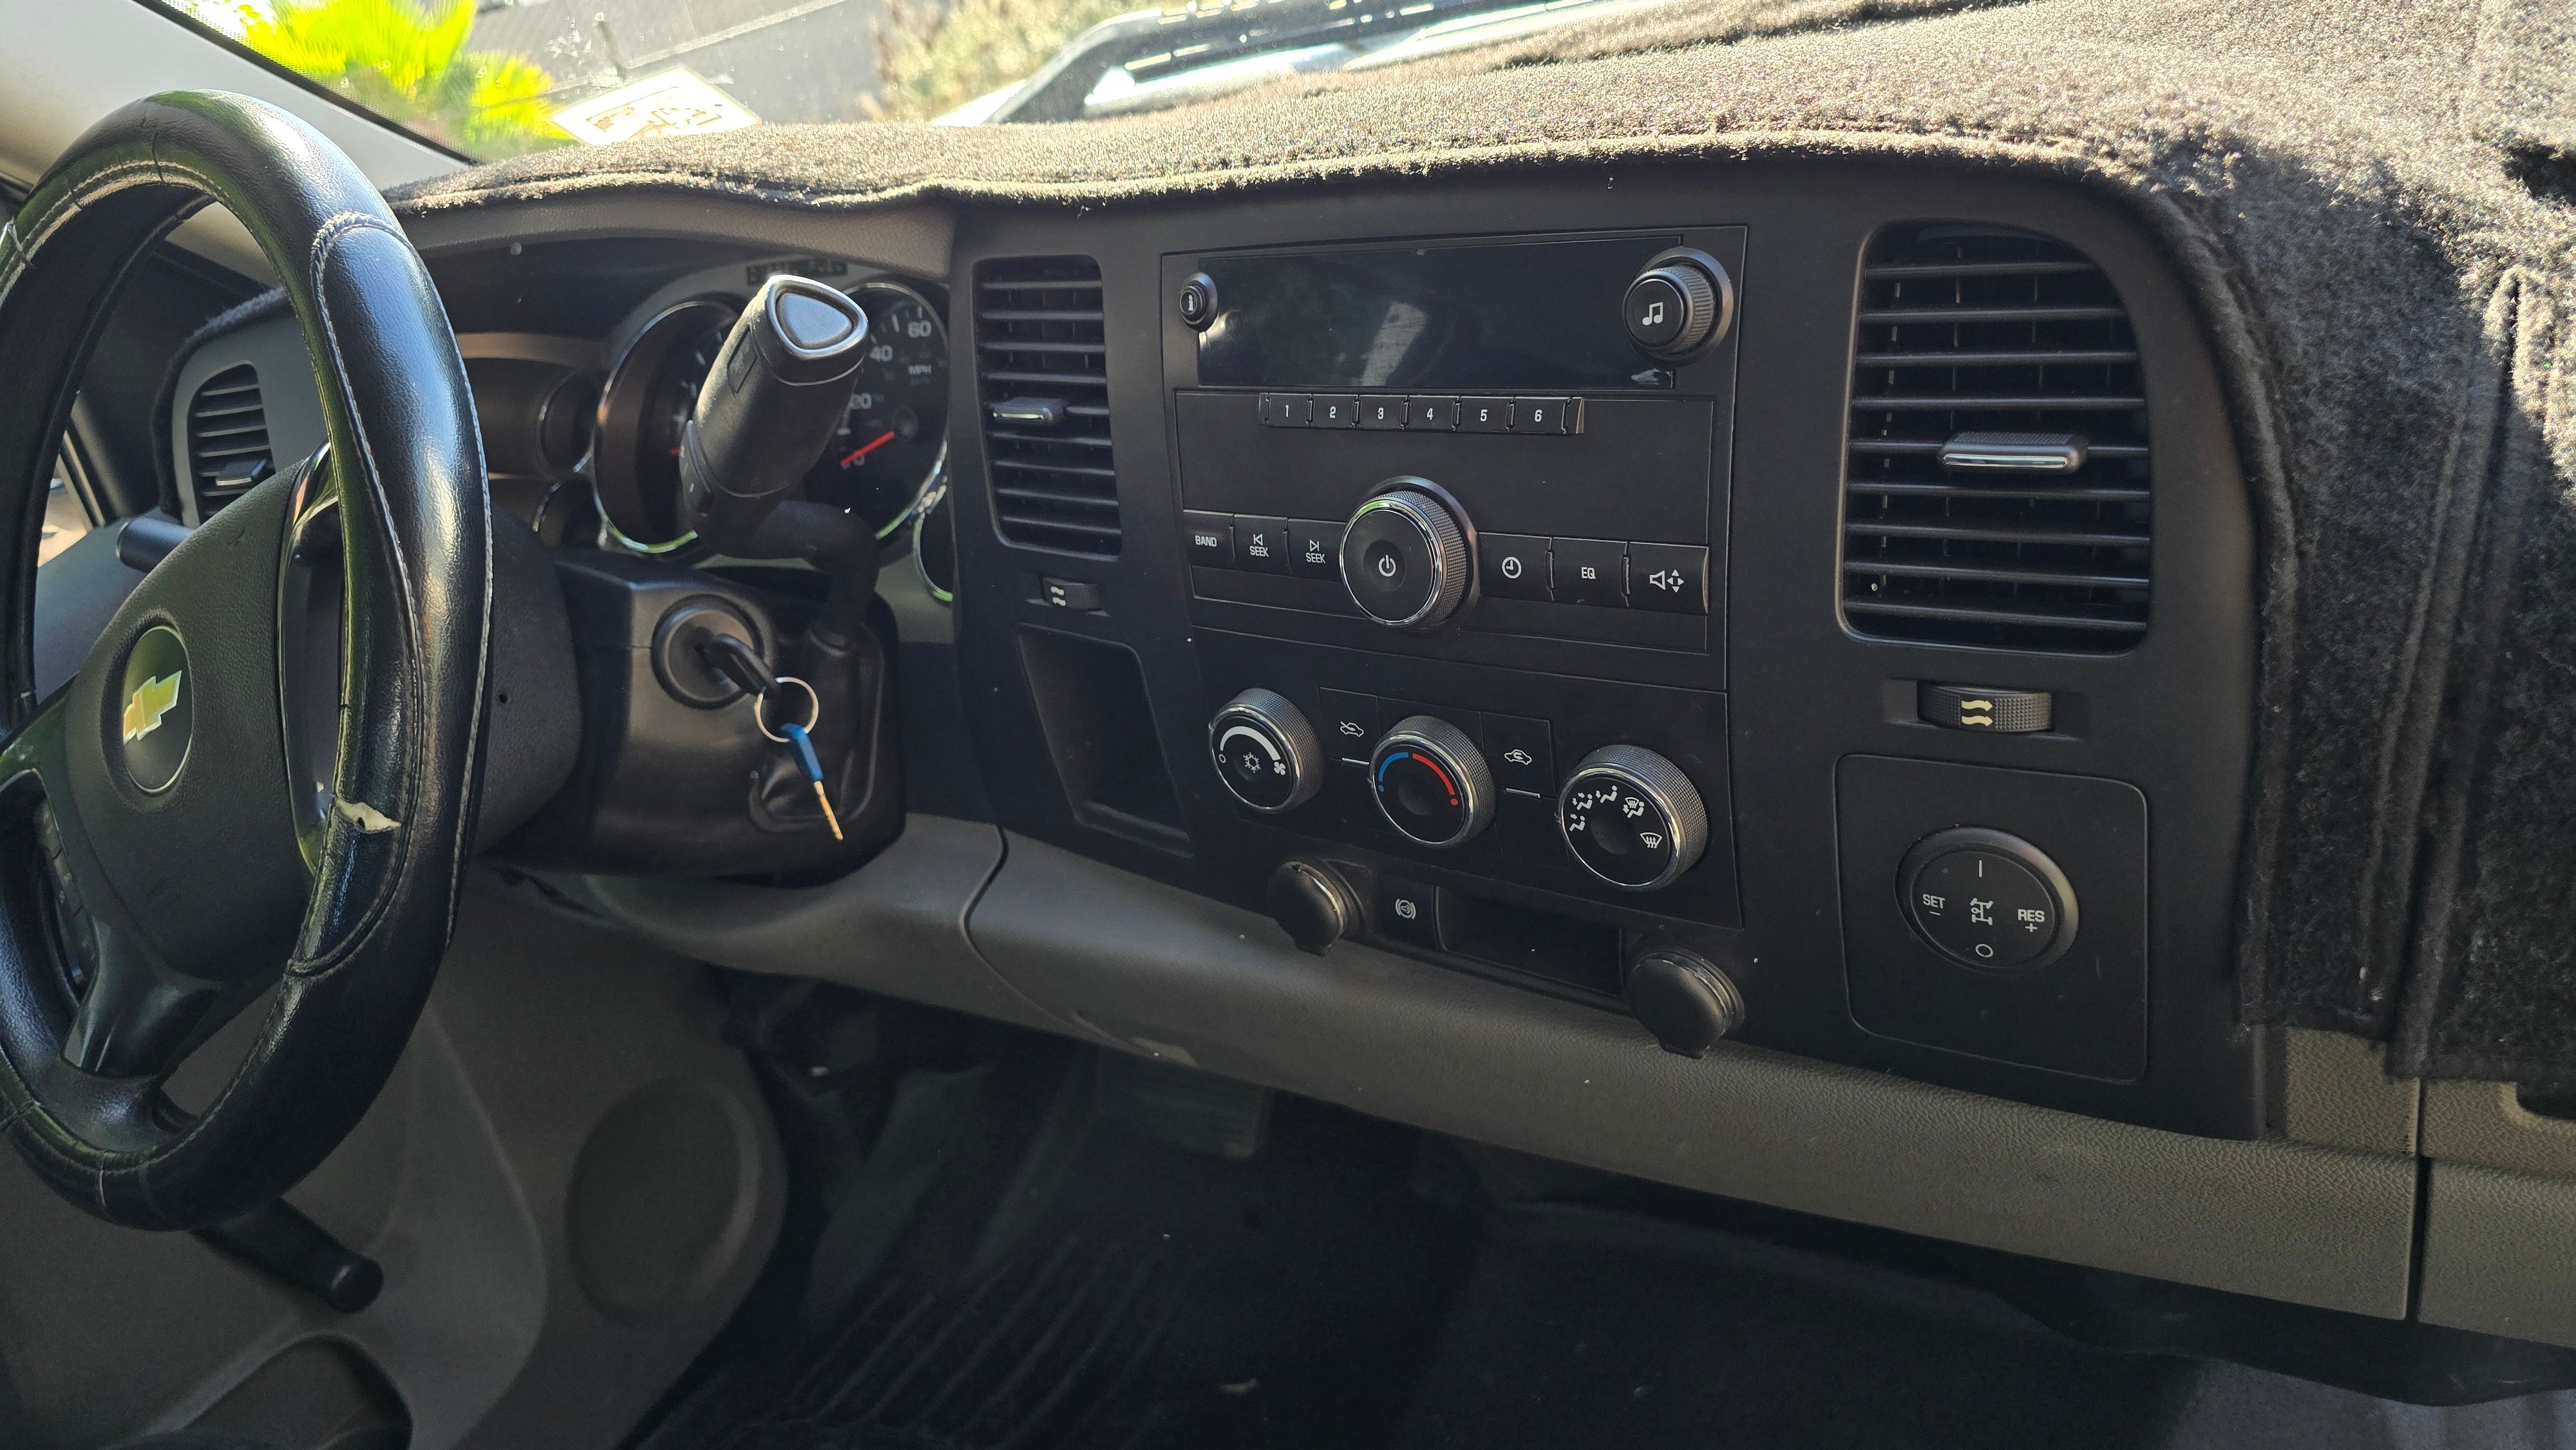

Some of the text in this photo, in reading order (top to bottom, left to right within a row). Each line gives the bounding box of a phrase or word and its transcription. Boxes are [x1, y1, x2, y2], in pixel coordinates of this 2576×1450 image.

[907, 320, 932, 339] 60
[869, 344, 893, 362] 40
[907, 364, 932, 375] MPH
[1285, 404, 1542, 422] 1 2 3 4 5 6
[1195, 533, 1217, 548] BAND
[1249, 545, 1269, 558] SEEK
[1305, 551, 1325, 565] SEEK
[1581, 566, 1596, 580] EQ
[1922, 893, 1946, 909] SET
[2017, 909, 2045, 923] RES
